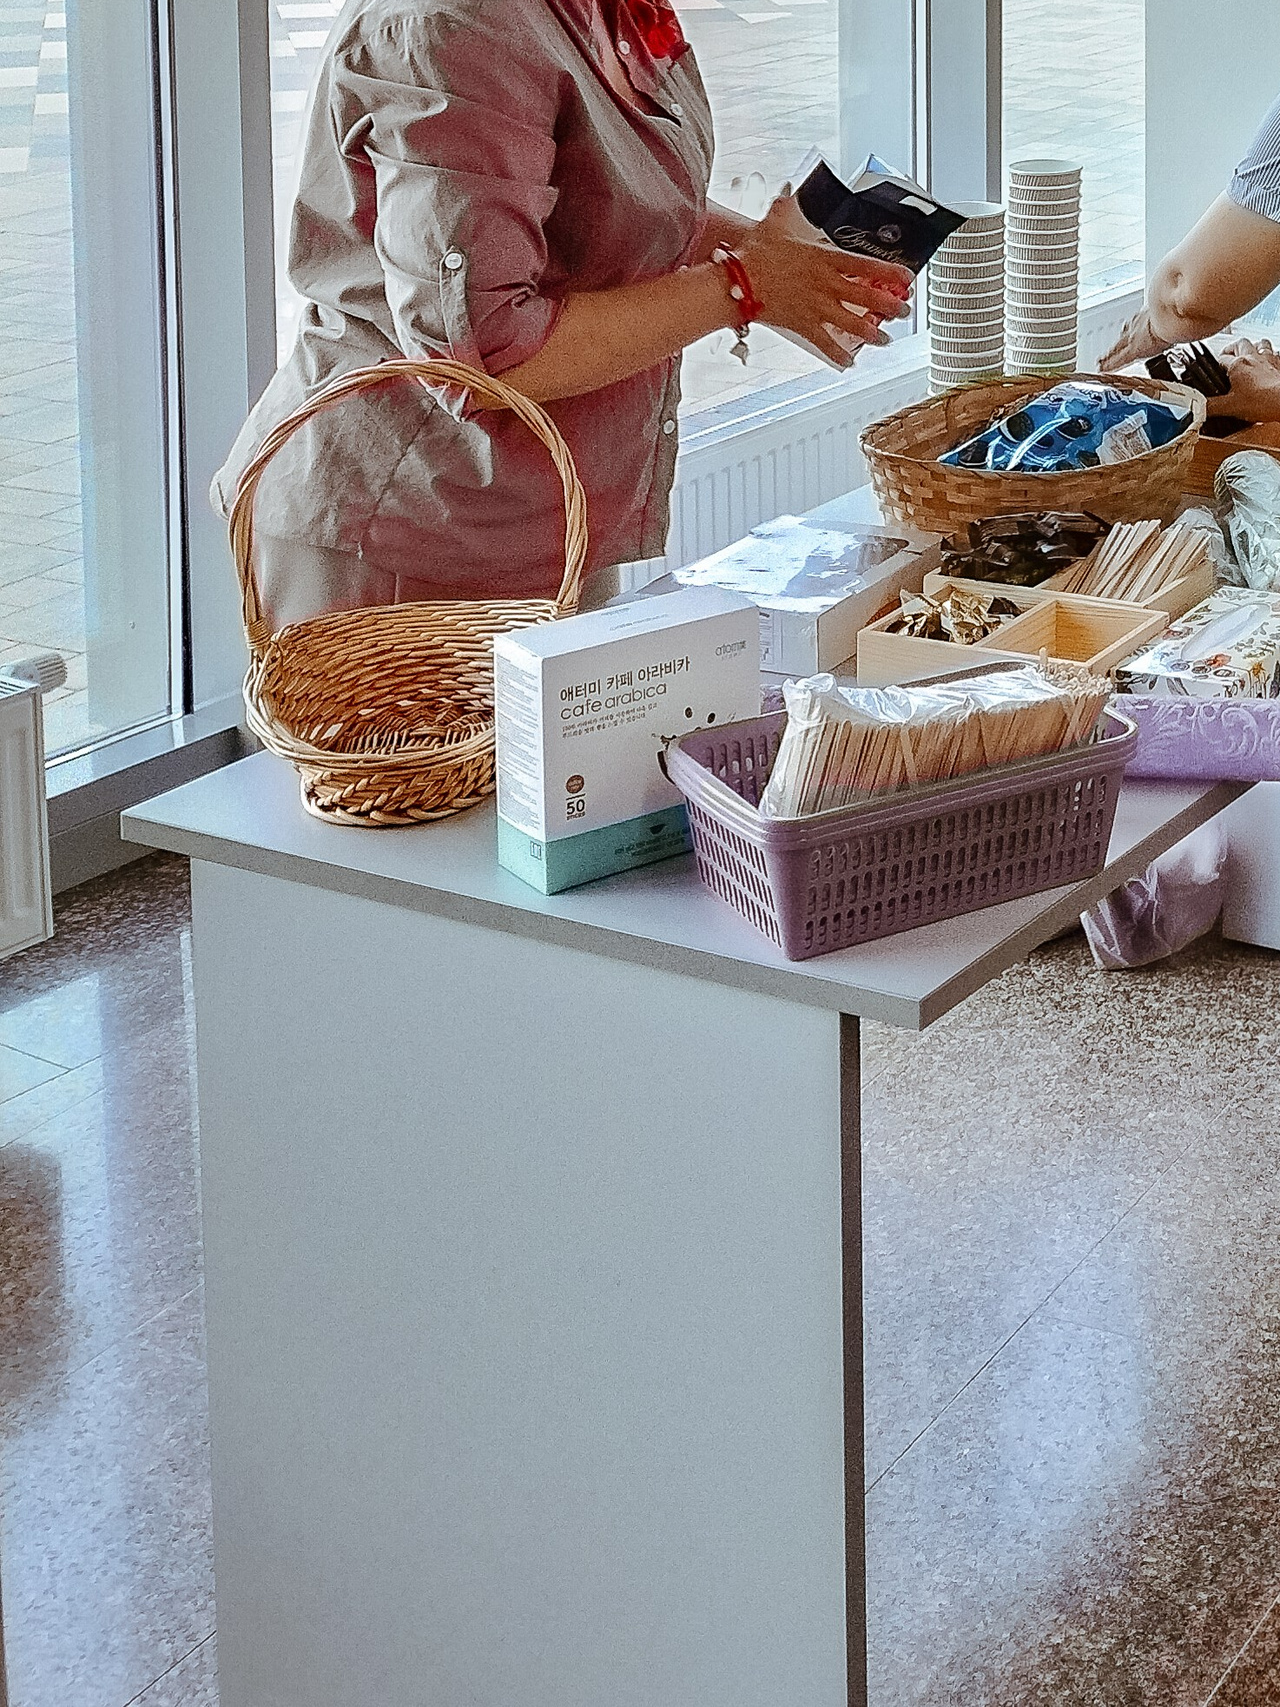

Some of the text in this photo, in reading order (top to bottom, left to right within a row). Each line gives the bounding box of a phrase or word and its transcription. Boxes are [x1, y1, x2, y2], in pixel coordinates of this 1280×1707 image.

[560, 655, 691, 701] 애터미 카페 아라비카
[560, 699, 602, 720] cafe
[604, 683, 667, 709] arabica
[566, 798, 586, 815] 50
